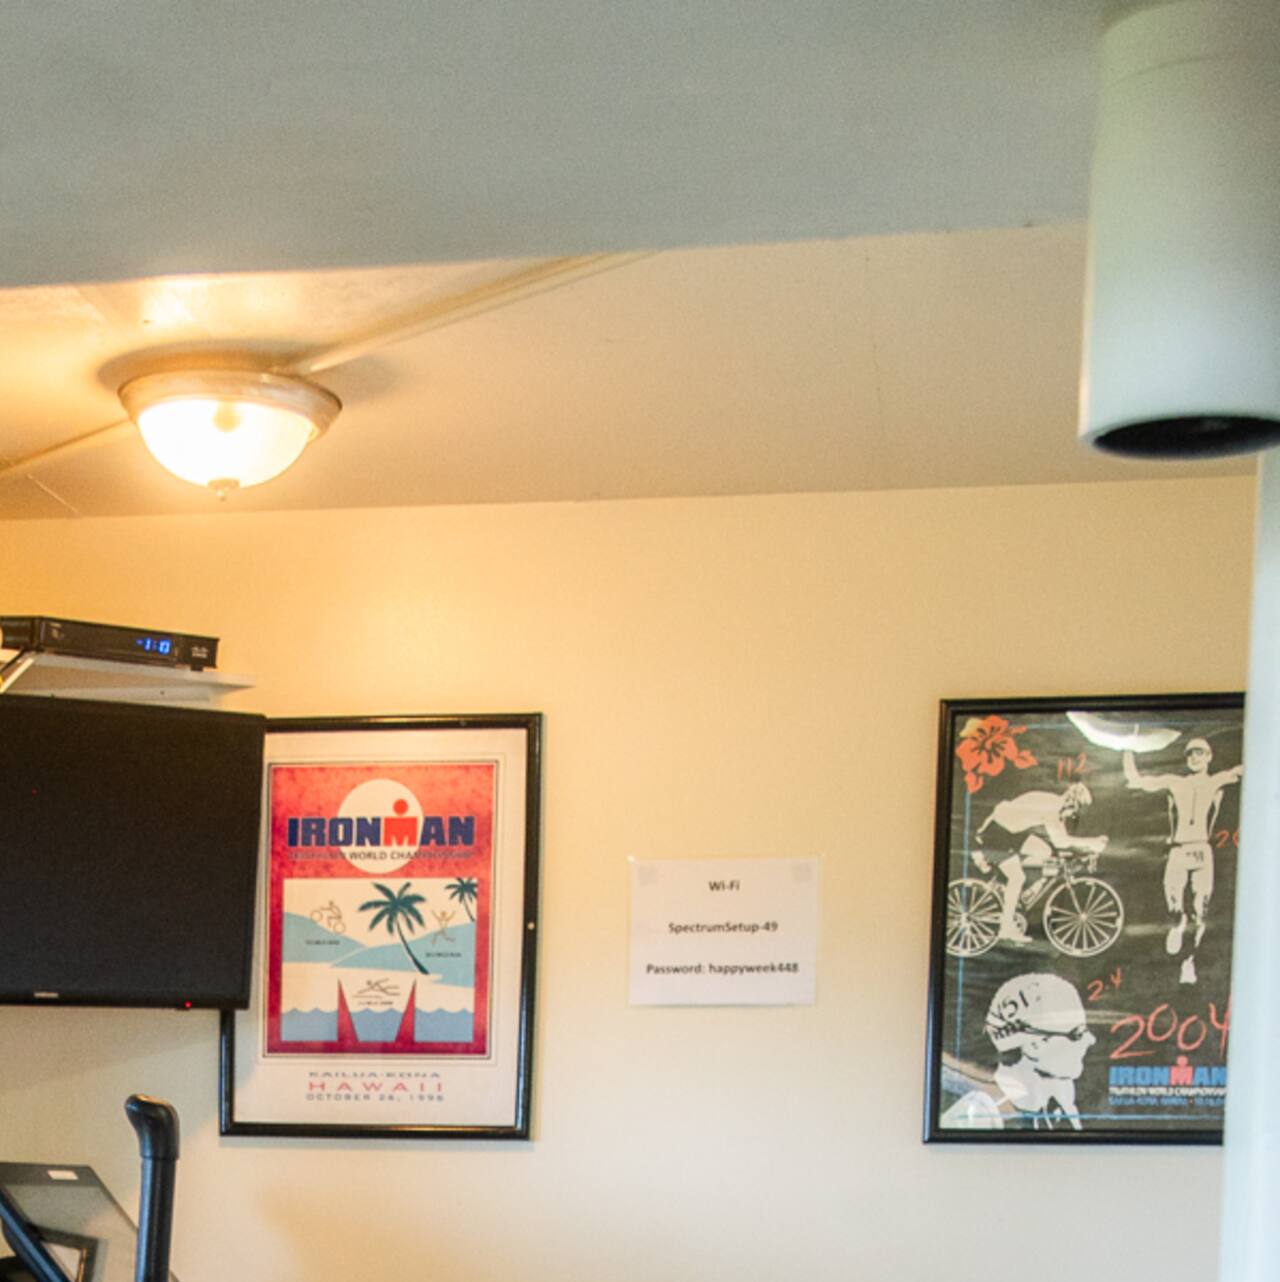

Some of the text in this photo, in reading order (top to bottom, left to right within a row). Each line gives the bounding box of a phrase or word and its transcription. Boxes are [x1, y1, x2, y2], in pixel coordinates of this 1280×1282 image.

[287, 798, 475, 847] IRONMAN
[349, 851, 389, 861] WORLD
[708, 880, 740, 892] Wi-Fi
[668, 921, 779, 935] SpectrumSetup-49
[646, 962, 800, 976] Password: happyweek448
[1108, 1001, 1232, 1060] 2004
[1108, 1055, 1227, 1087] IRONMAN
[308, 1081, 444, 1093] HAWAII
[305, 1093, 371, 1102] OCTOBER
